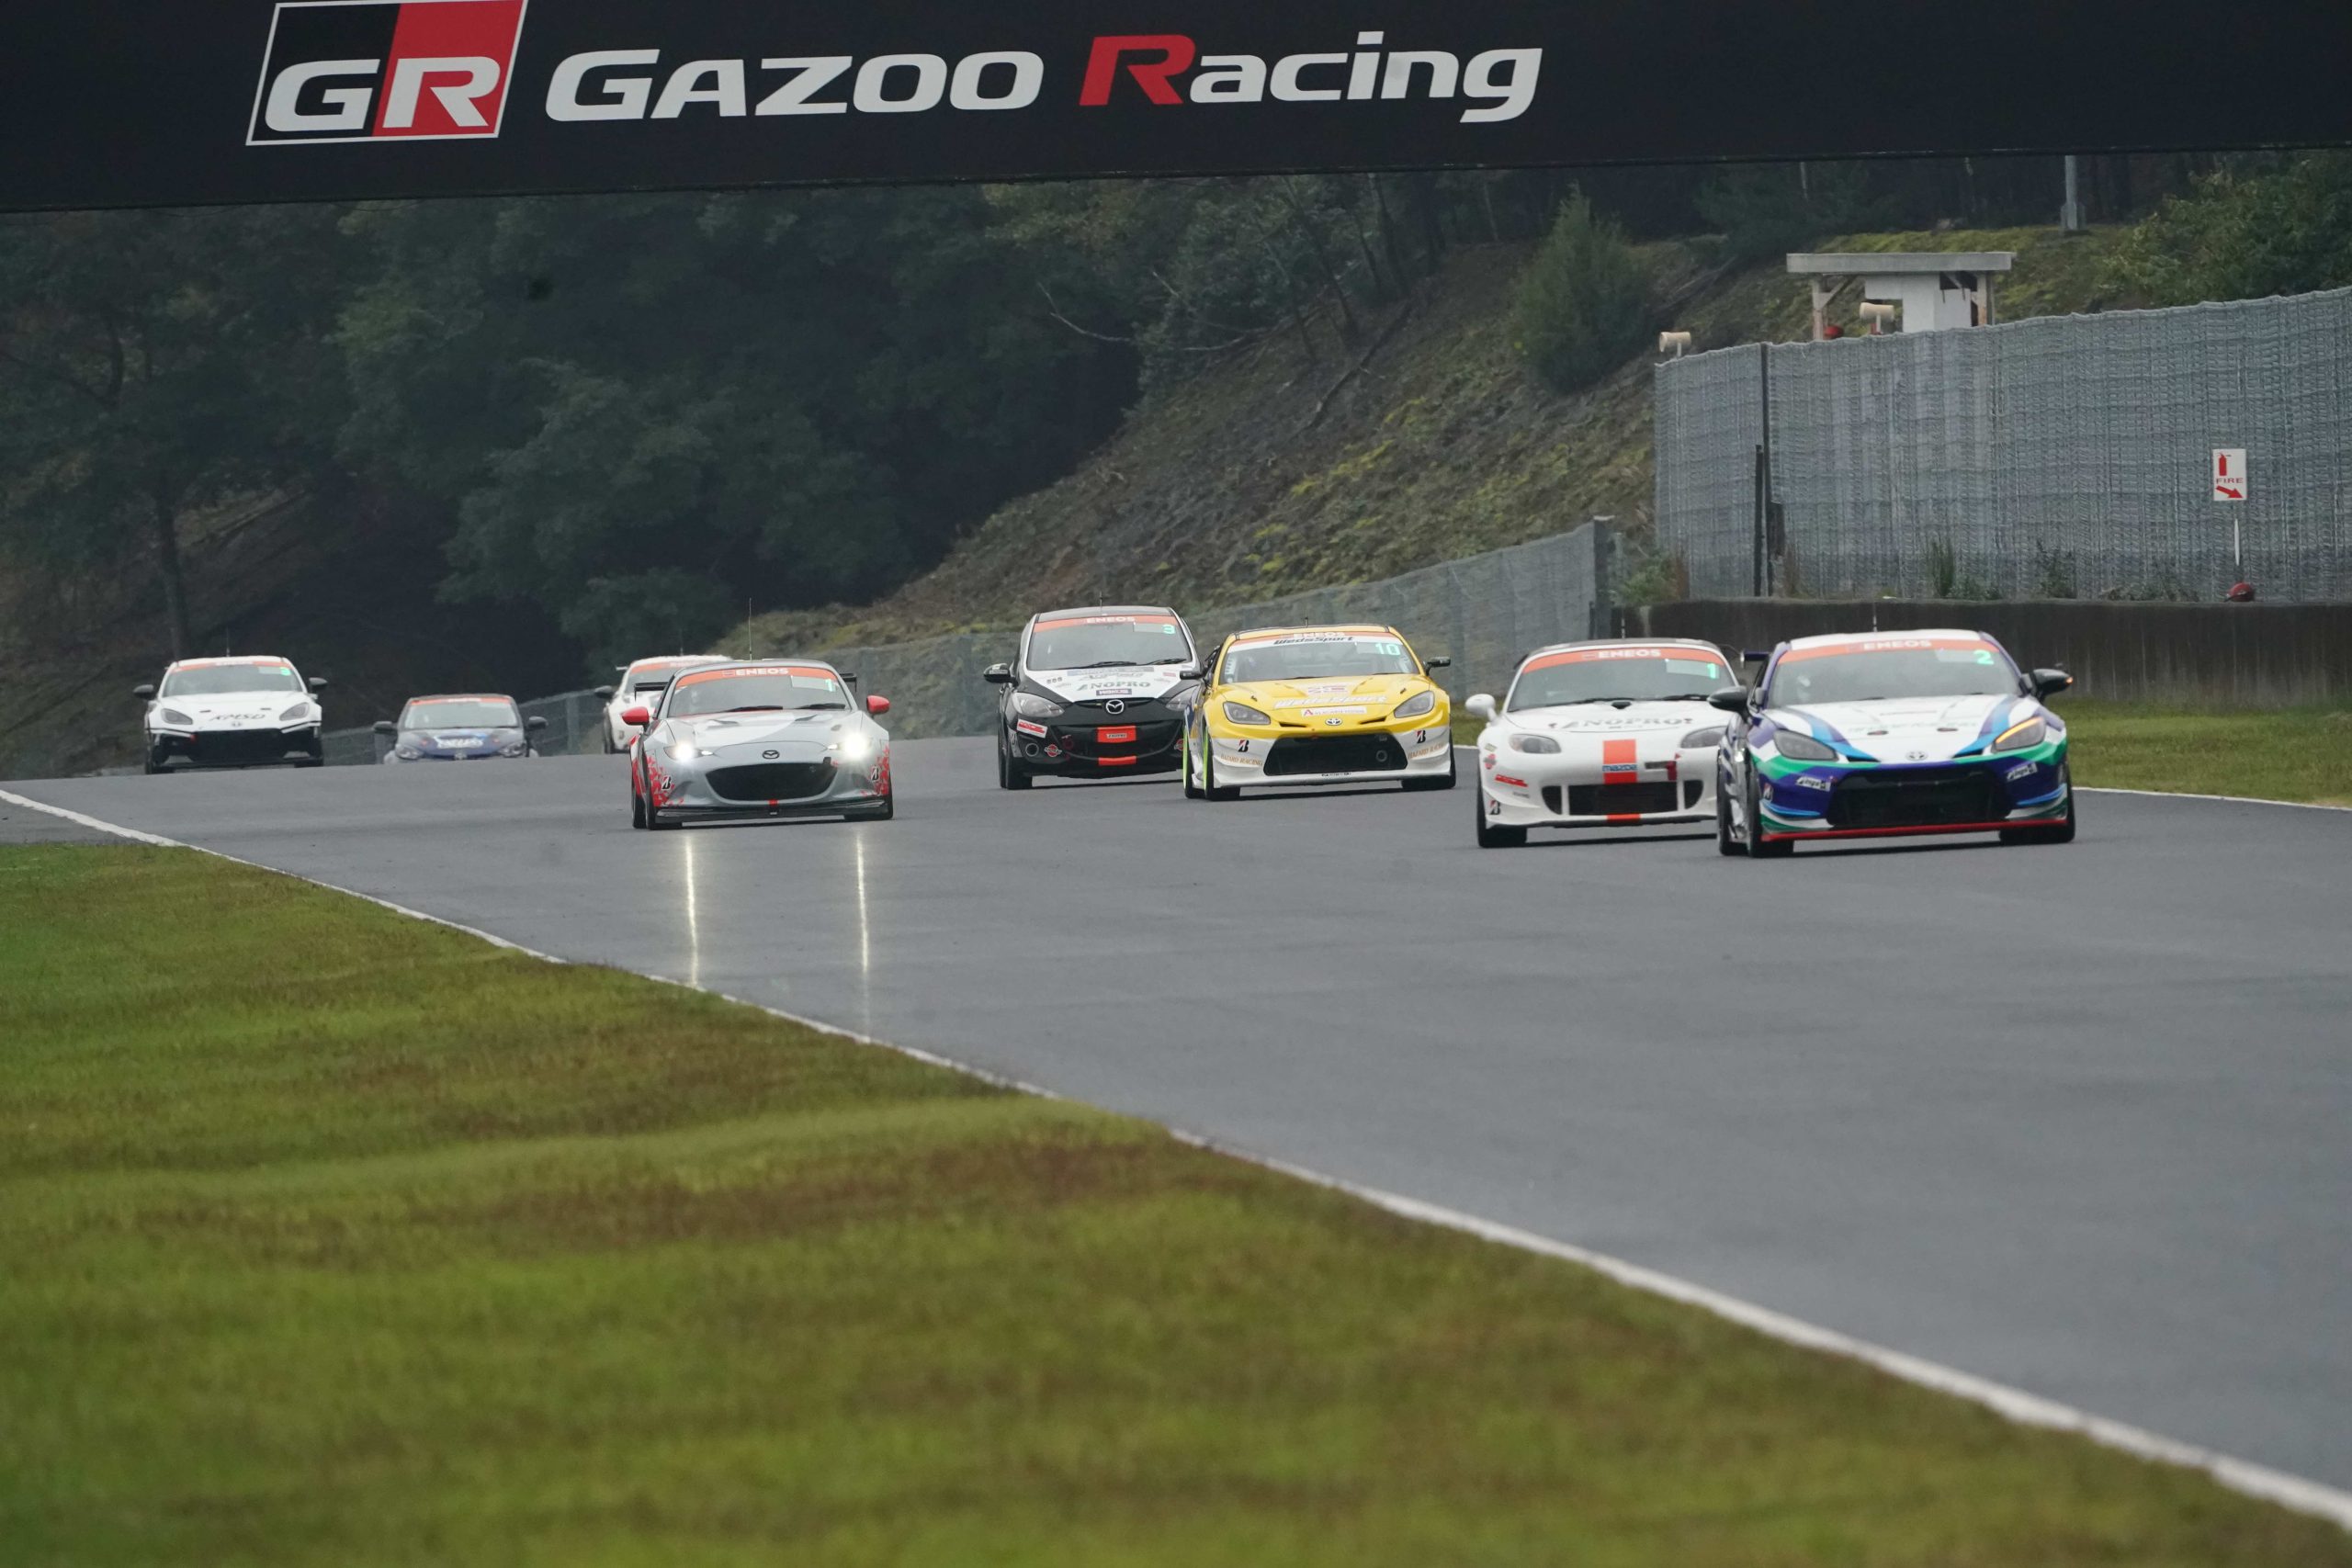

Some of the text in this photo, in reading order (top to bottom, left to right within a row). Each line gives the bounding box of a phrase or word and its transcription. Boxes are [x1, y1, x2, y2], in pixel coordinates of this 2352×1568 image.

[546, 30, 1543, 123] GAZOO Racing
[266, 56, 501, 131] GR
[1273, 636, 1354, 645] WedsSport
[1863, 639, 1932, 650] ENEOS
[1374, 643, 1401, 656] 10
[1598, 649, 1662, 659] ENEOS
[1973, 649, 1995, 665] 2
[736, 668, 789, 676] ENEOS
[1706, 662, 1717, 679] 1
